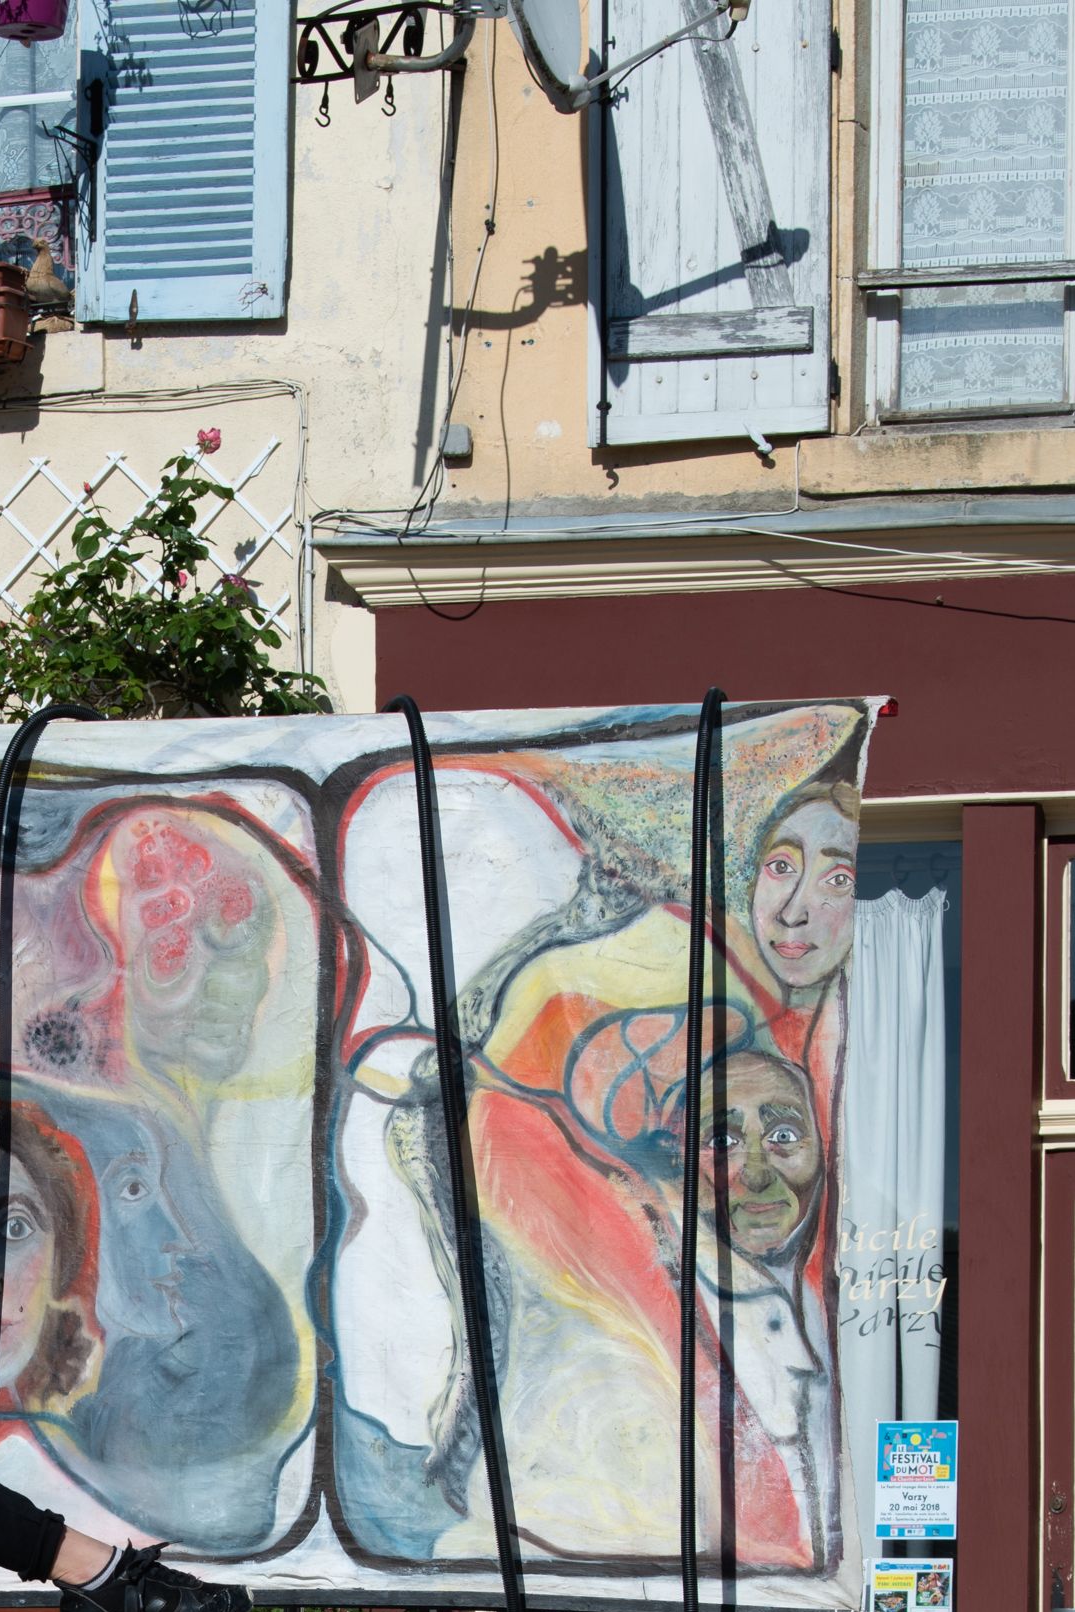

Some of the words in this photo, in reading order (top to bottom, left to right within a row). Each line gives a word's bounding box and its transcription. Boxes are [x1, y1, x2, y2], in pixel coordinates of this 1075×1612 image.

[896, 1466, 907, 1475] DU
[908, 1464, 934, 1475] MOT
[902, 1491, 928, 1502] Varzy
[889, 1503, 900, 1512] 20
[903, 1503, 918, 1511] mai
[920, 1503, 940, 1512] 2018
